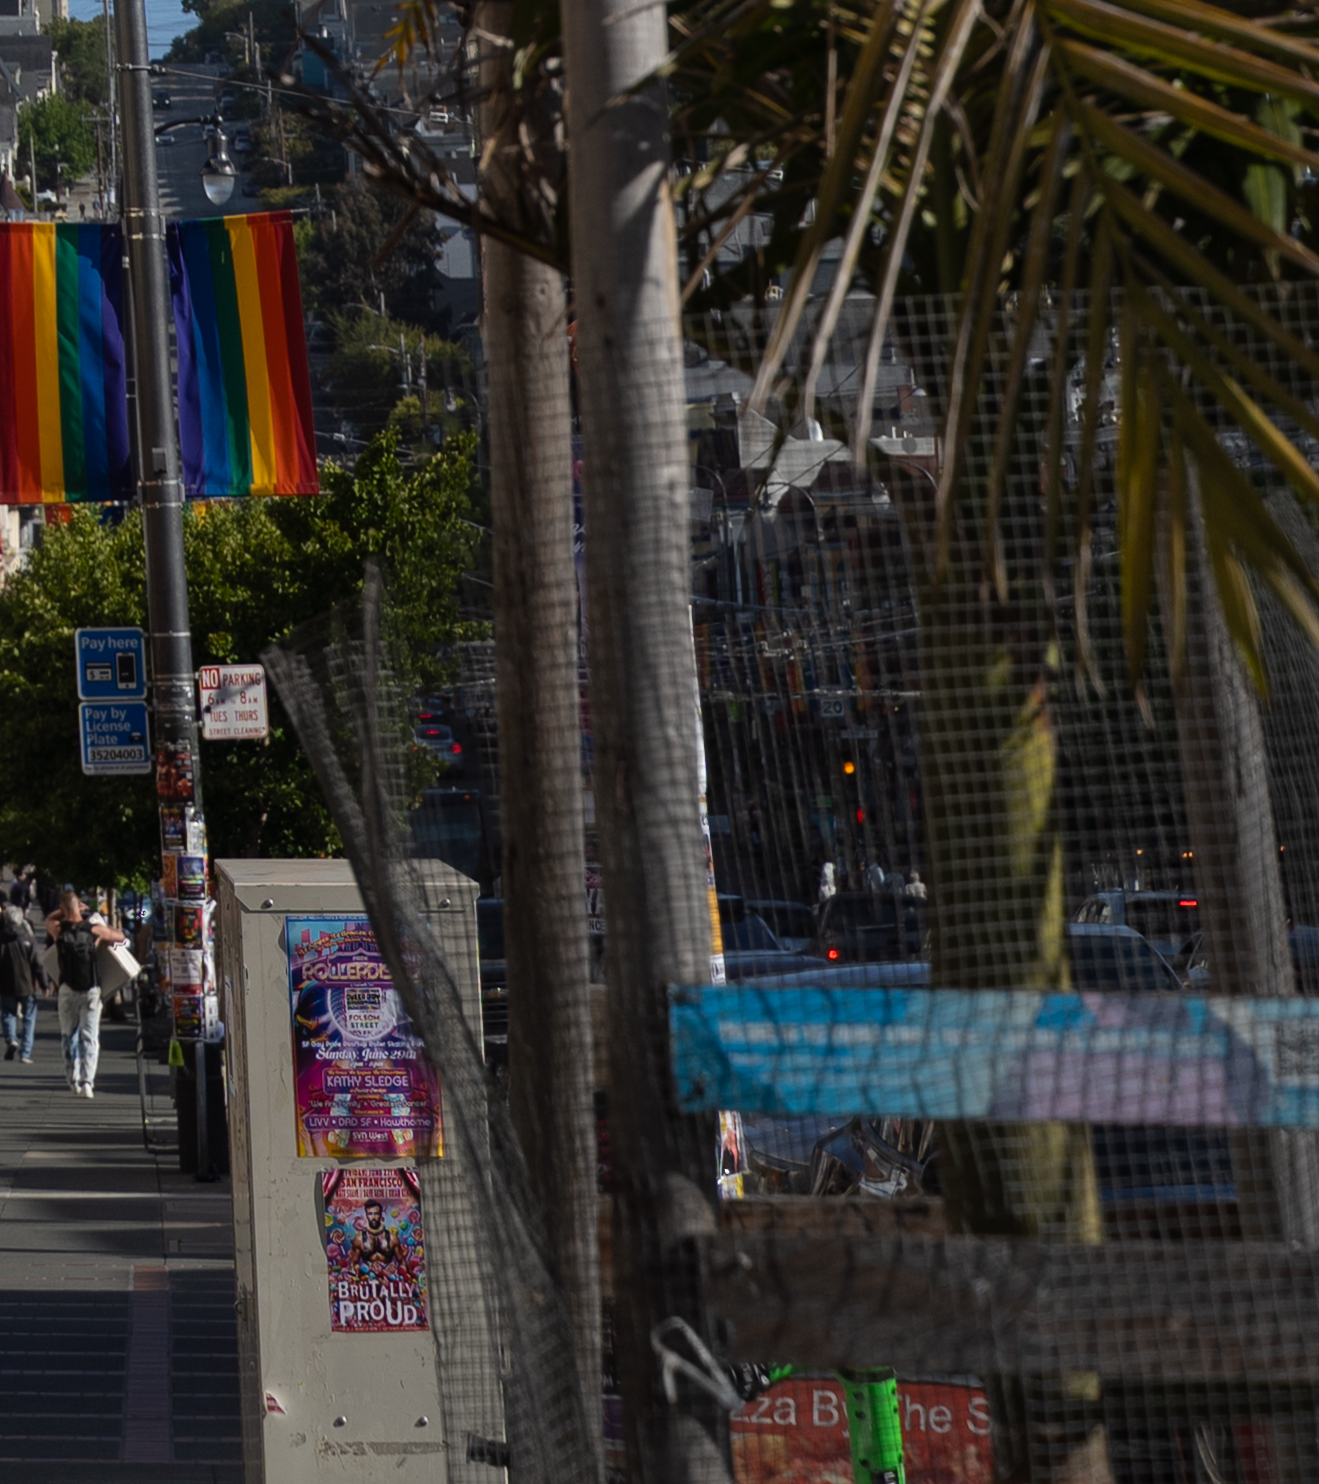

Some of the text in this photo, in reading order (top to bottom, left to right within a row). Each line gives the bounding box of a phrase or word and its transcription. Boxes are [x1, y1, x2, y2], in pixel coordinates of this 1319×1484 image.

[82, 636, 138, 652] Pay here
[203, 669, 262, 688] NO PARKING
[85, 707, 127, 722] Pay by
[210, 709, 258, 723] TUES THURS
[86, 721, 131, 732] License
[87, 733, 118, 745] Plate
[90, 749, 143, 761] 35204003
[302, 962, 393, 980] ROLLERDIS
[362, 1049, 389, 1061] June
[327, 1076, 409, 1086] KATHY SLEDGE
[309, 1118, 330, 1126] LIVV
[338, 1118, 358, 1126] DAD
[360, 1118, 372, 1126] SF
[369, 1132, 389, 1140] West
[341, 1177, 403, 1188] SAN FRANCISCO
[340, 1299, 418, 1326] PROUD
